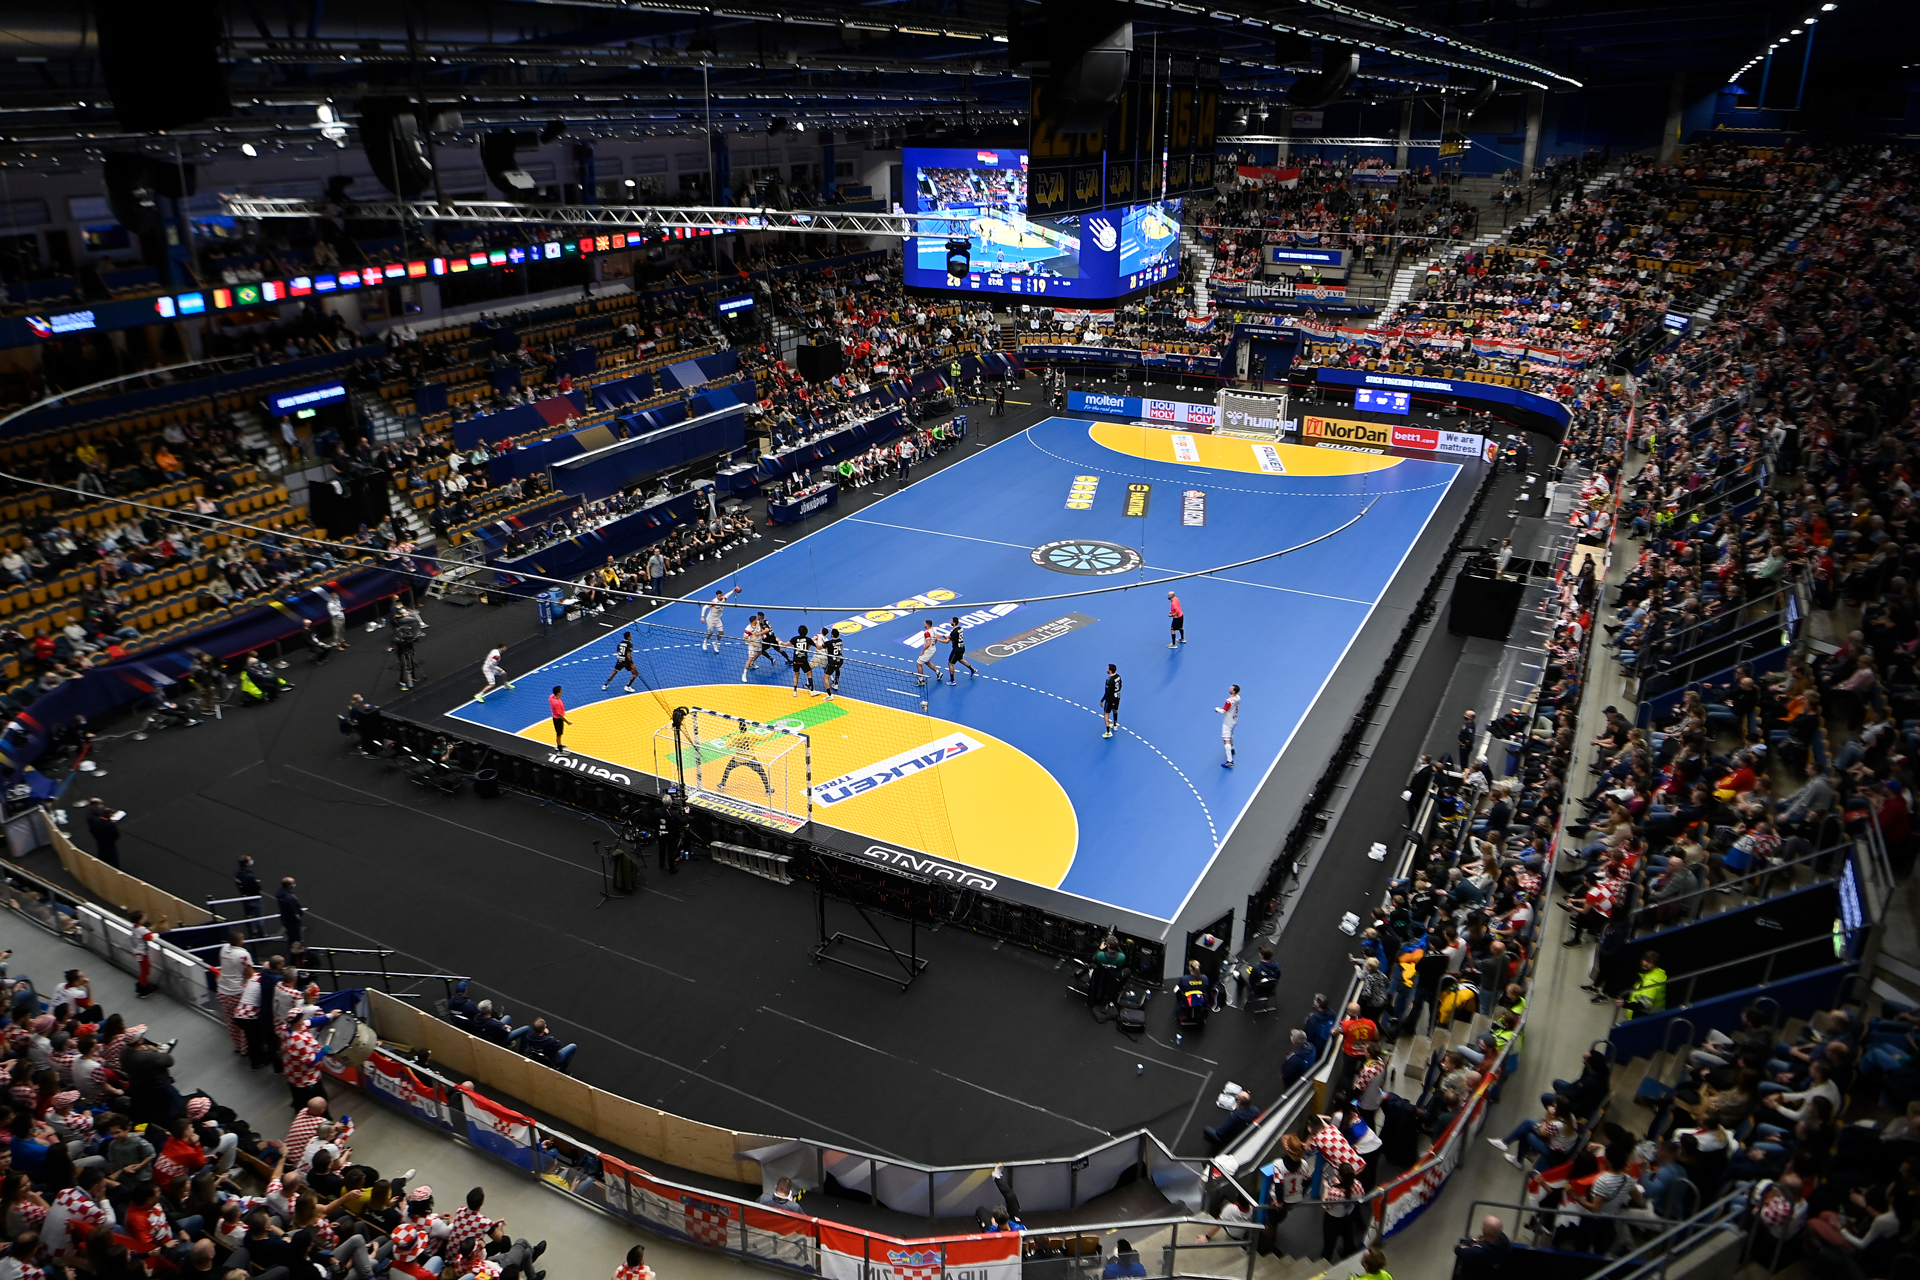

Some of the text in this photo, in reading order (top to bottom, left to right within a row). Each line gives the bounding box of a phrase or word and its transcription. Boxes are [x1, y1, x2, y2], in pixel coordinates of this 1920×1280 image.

[1171, 91, 1192, 149] 15
[1197, 92, 1217, 148] 14
[1033, 278, 1046, 293] 19
[1365, 375, 1384, 384] STICK
[1085, 395, 1124, 408] molten
[1151, 401, 1175, 411] LIQUI
[1151, 409, 1175, 420] MOLY
[1188, 405, 1213, 415] LIQUI
[1188, 413, 1213, 424] MOLY
[1243, 413, 1298, 431] hummel
[1324, 422, 1388, 443] NorDan
[1394, 431, 1436, 444] bett1.com
[1446, 433, 1474, 444] We are
[1440, 443, 1479, 454] mattress.
[1262, 446, 1284, 472] FALKEN
[800, 494, 828, 515] JÖNKÖPING
[1127, 492, 1145, 516] HARTING
[1030, 540, 1075, 565] FALKEN
[1096, 549, 1141, 575] FALKEN
[796, 642, 808, 652] 90
[821, 742, 969, 804] FALKEN
[814, 775, 853, 793] TYRES
[1353, 1029, 1369, 1040] 13
[1290, 1179, 1298, 1194] 1
